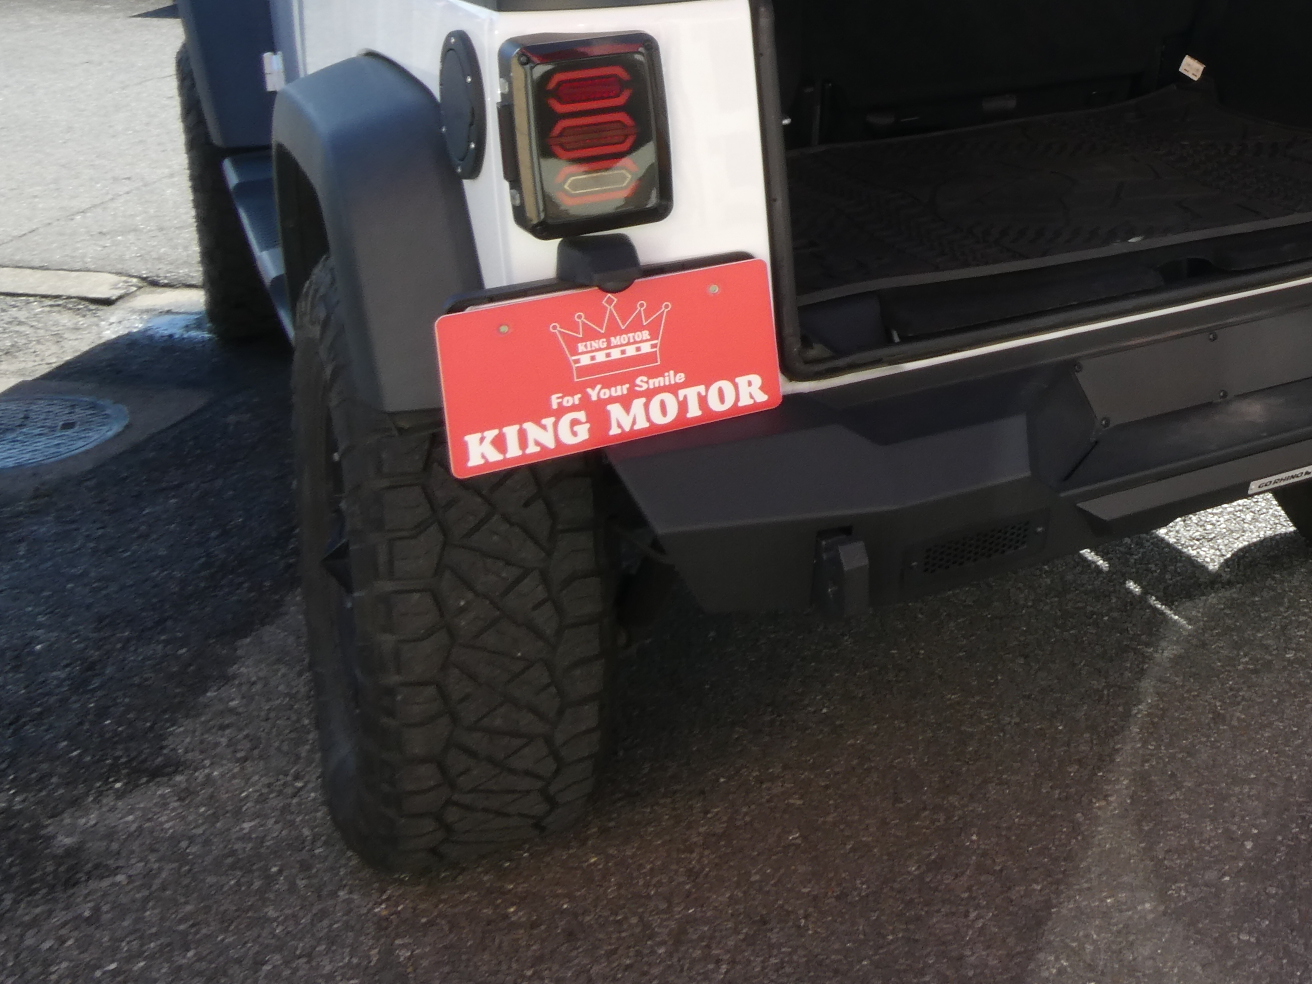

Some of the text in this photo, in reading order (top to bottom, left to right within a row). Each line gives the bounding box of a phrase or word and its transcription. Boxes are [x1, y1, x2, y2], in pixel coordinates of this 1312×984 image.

[577, 330, 651, 353] KING MOTOR
[550, 370, 686, 410] For Your Smile
[464, 373, 769, 468] KING MOTOR
[1258, 471, 1304, 489] GO RHINO
